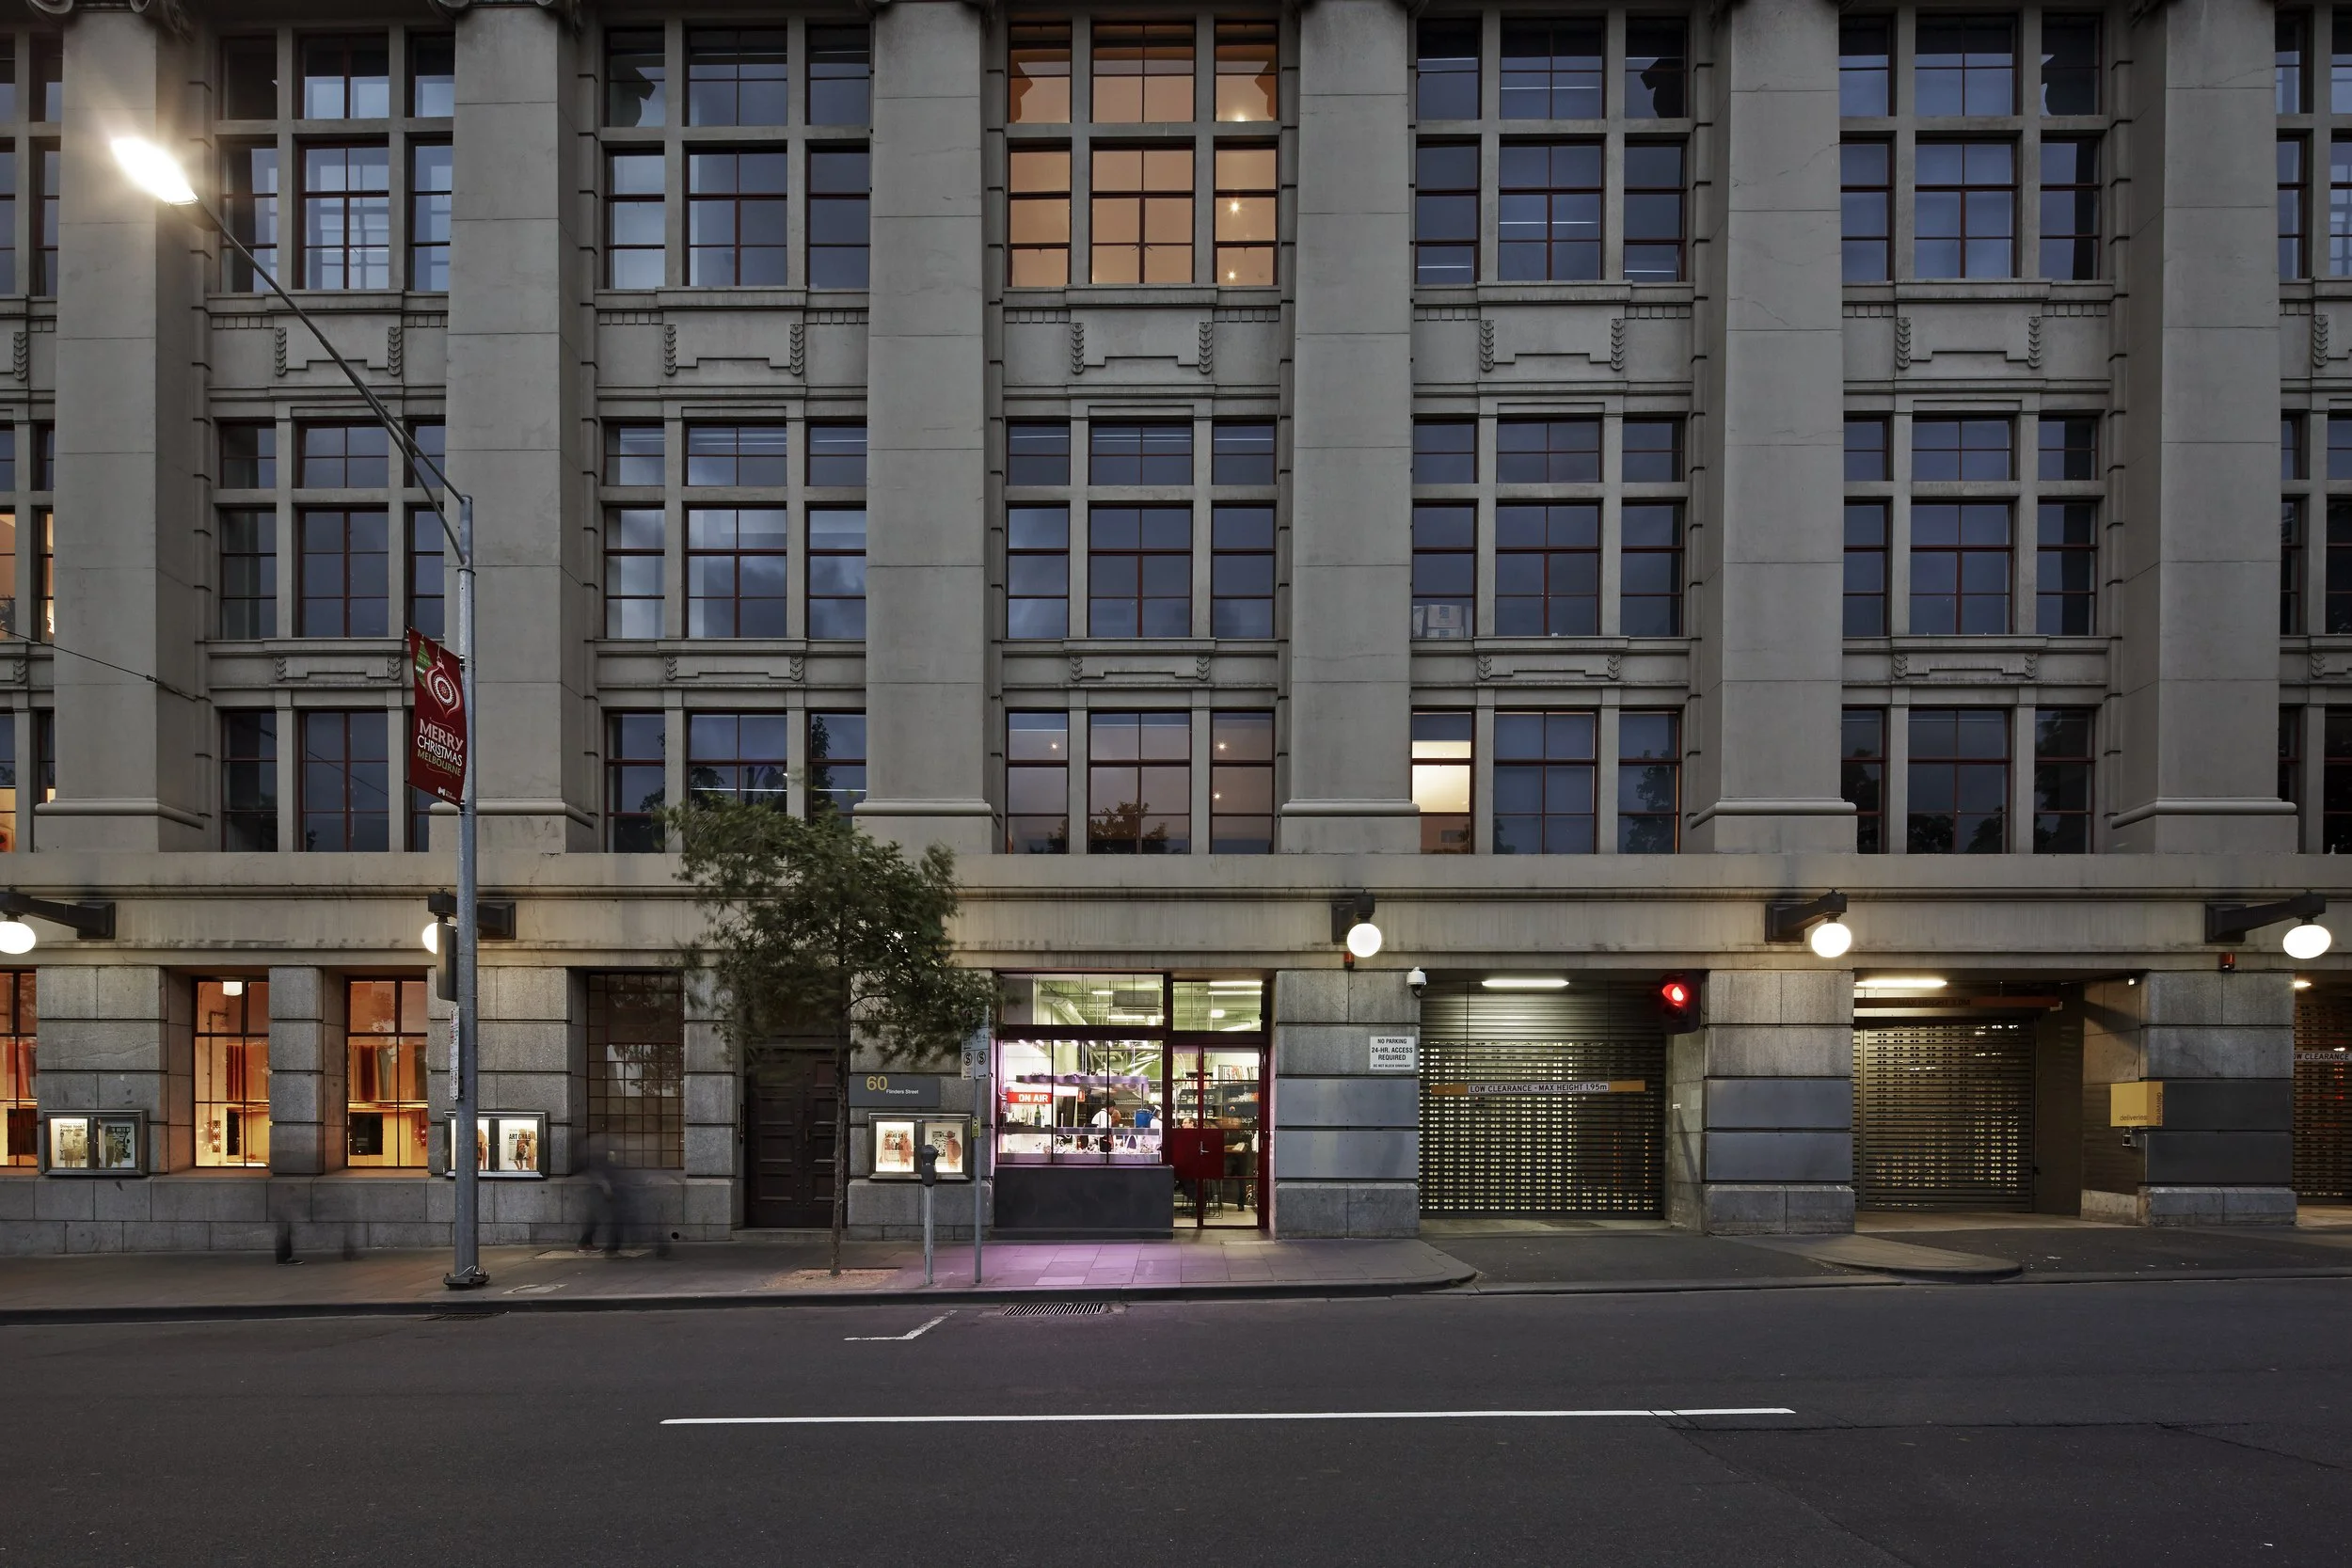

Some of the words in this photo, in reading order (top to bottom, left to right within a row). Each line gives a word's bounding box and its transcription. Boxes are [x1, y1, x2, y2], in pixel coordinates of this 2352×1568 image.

[420, 718, 464, 752] MERRY
[417, 735, 463, 767] CHRISTMAS
[417, 748, 461, 777] MELBOURNE
[866, 1075, 888, 1091] 60
[1018, 1094, 1031, 1102] ON
[1033, 1094, 1048, 1102] AIR
